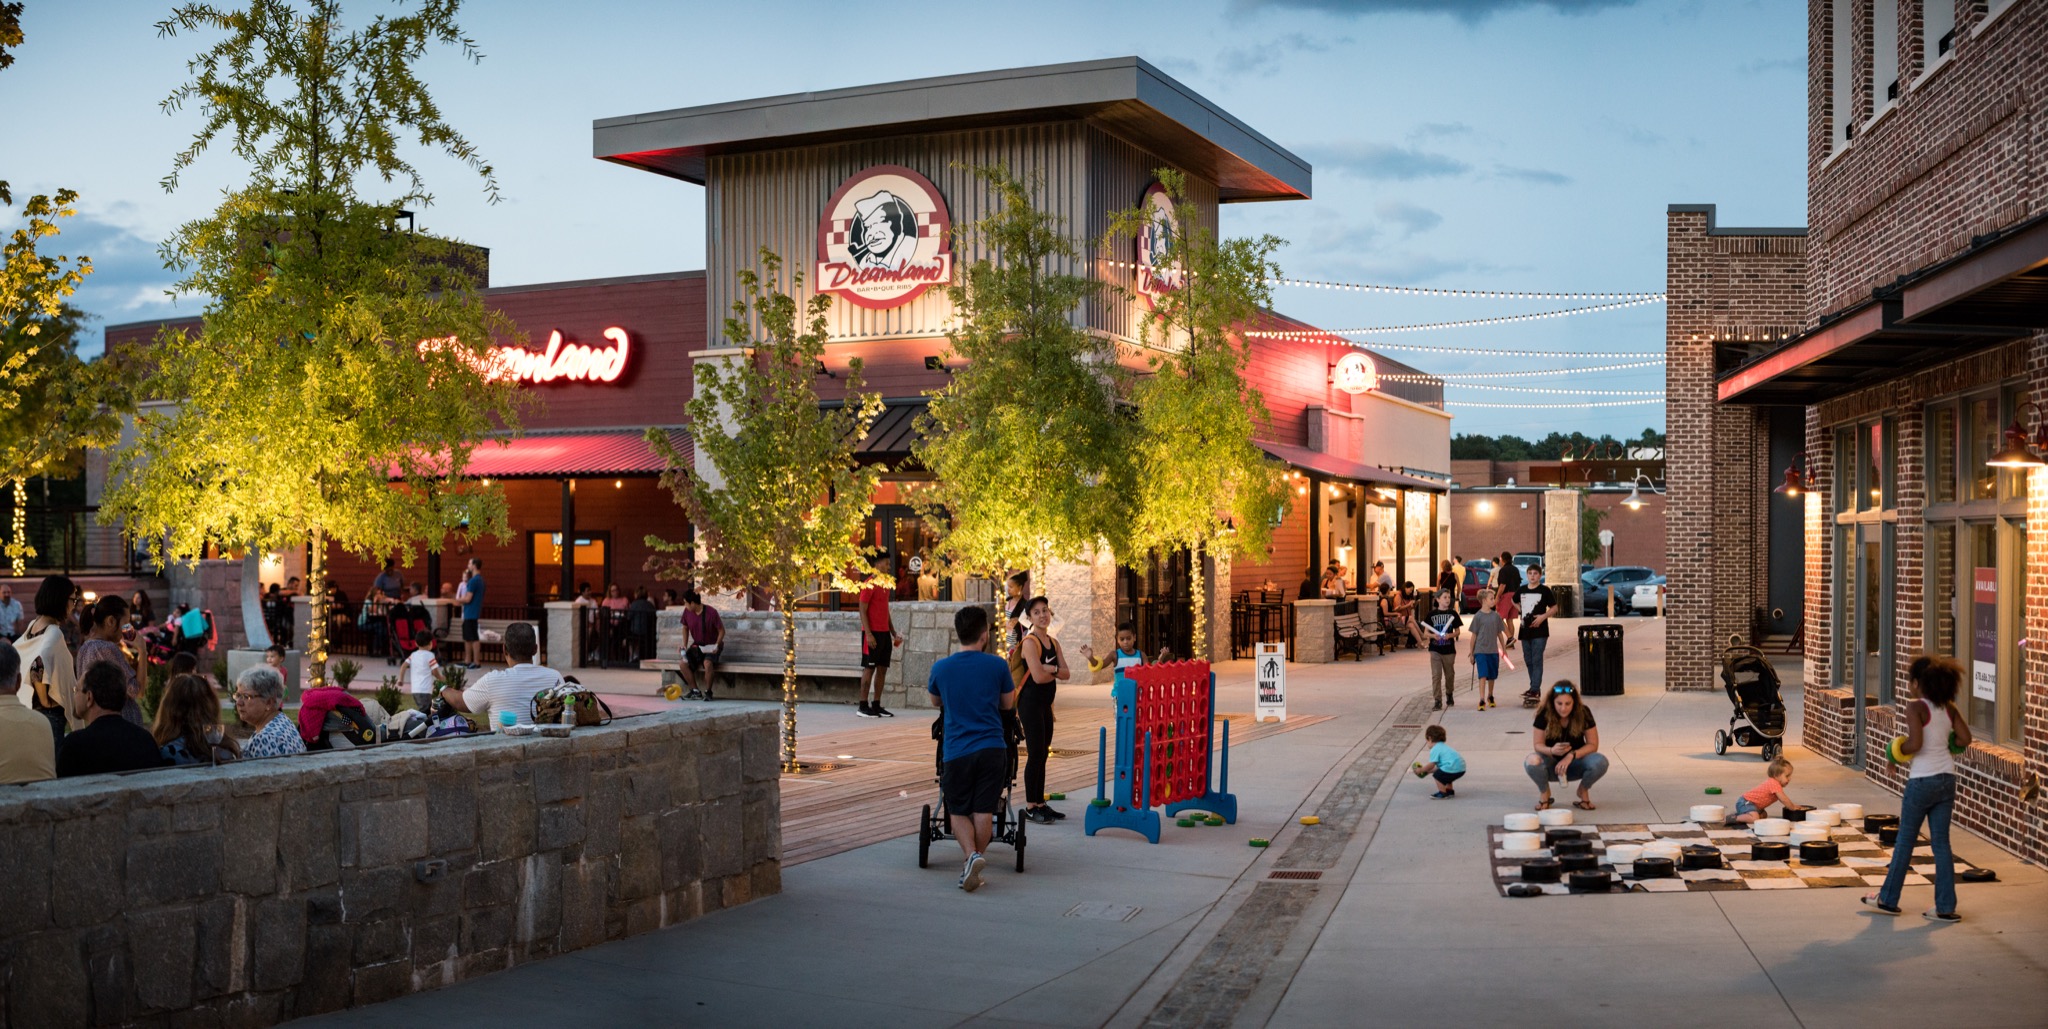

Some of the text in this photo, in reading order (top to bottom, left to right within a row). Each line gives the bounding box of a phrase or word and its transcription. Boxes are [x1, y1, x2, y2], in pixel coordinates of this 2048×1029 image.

[824, 256, 945, 288] Dreamland
[1259, 681, 1276, 690] WALK
[1259, 694, 1283, 703] WHEELS
